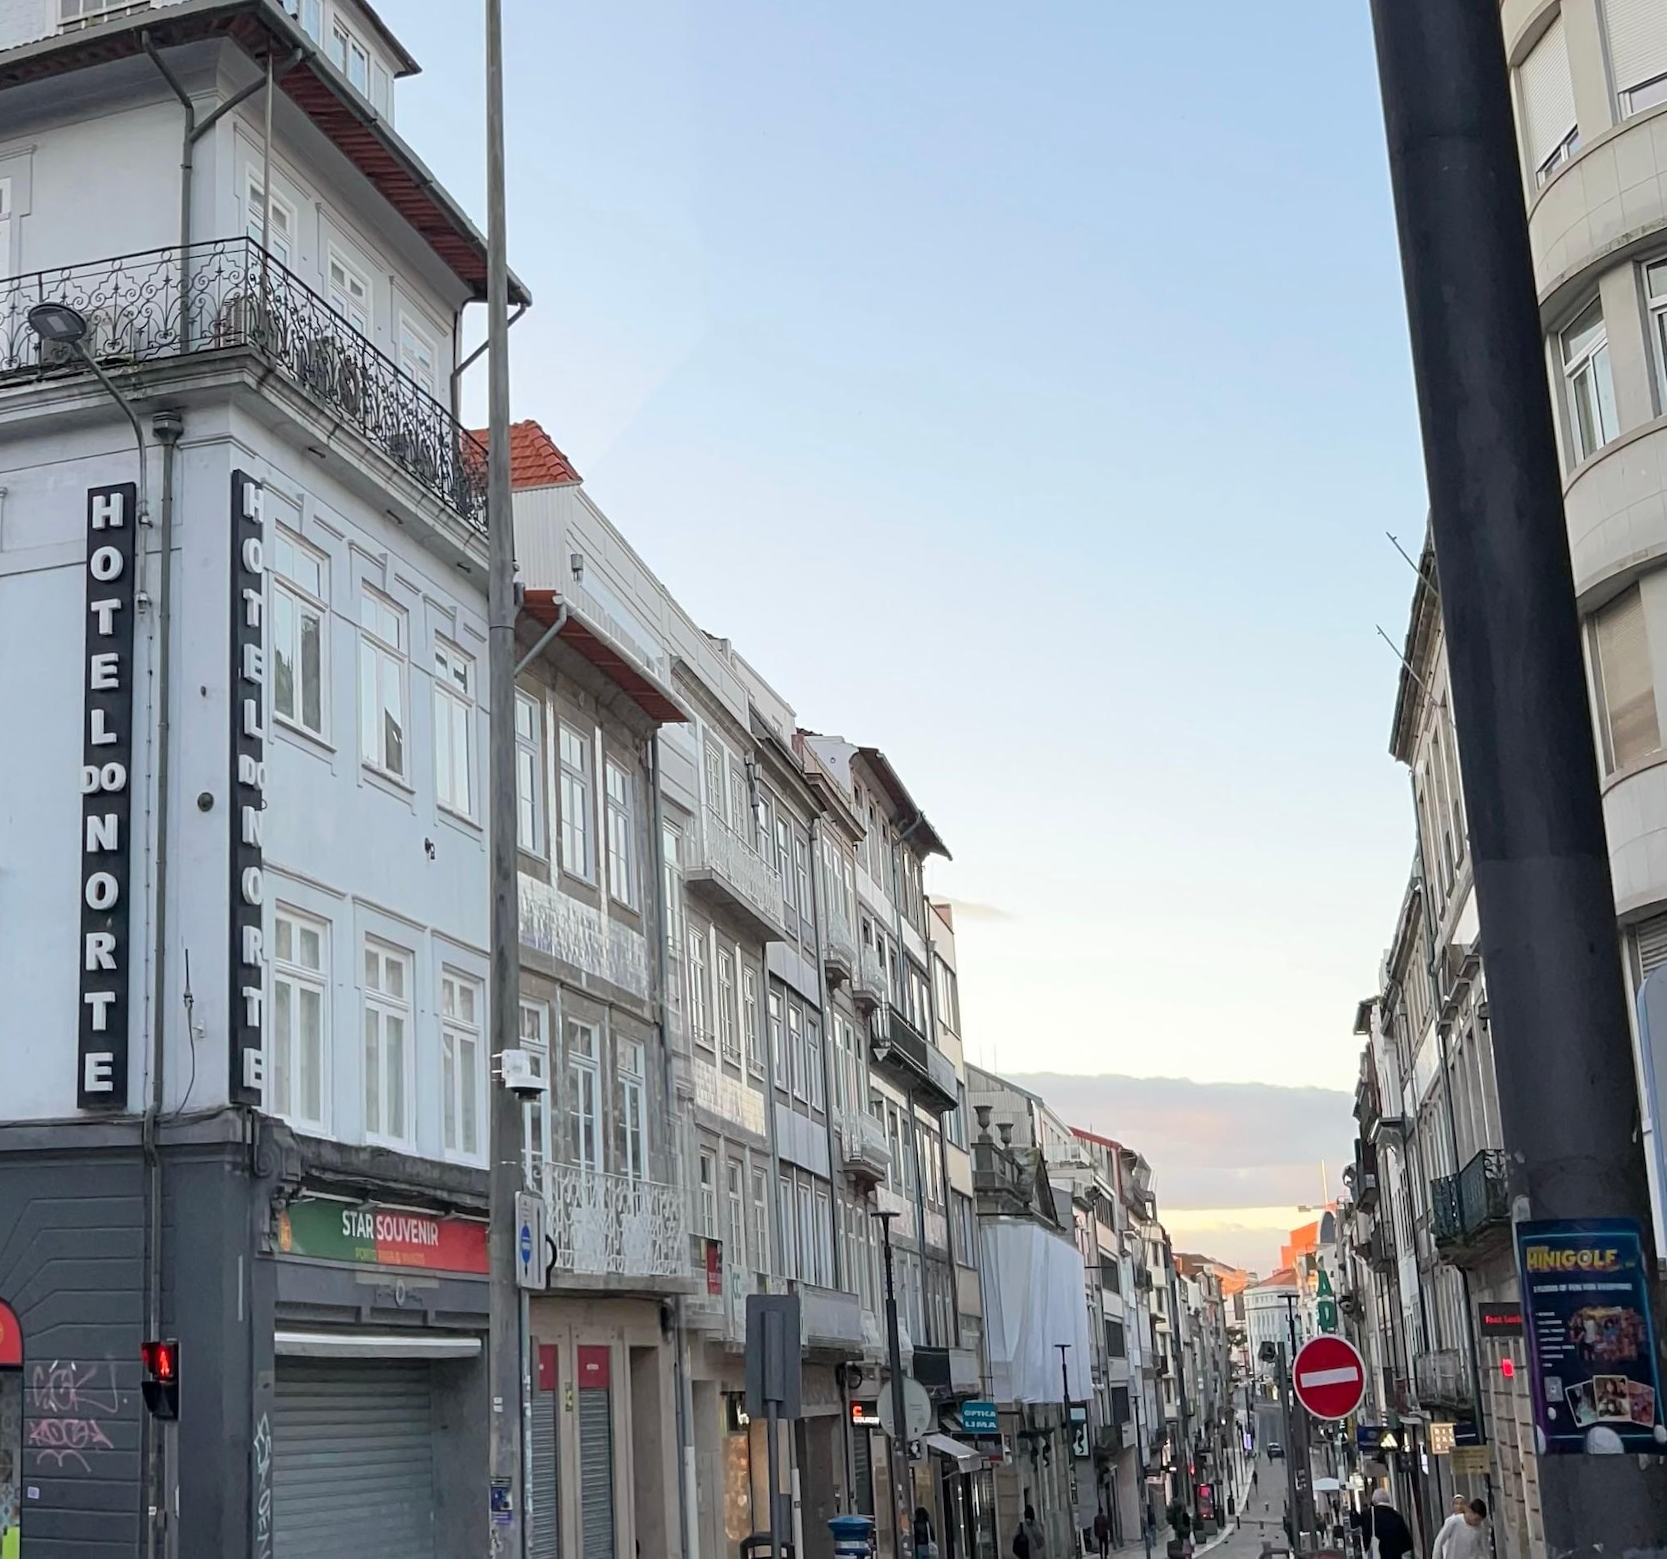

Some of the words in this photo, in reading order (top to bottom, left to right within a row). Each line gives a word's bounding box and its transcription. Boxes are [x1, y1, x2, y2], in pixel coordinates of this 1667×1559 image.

[88, 492, 126, 746] HOTEL
[241, 482, 264, 739] HOTEL
[80, 760, 127, 795] DO
[83, 813, 120, 1093] NORTE
[241, 805, 264, 1092] NORTE
[342, 1210, 374, 1239] STAR
[376, 1215, 439, 1246] SOUVENIR
[1526, 1247, 1618, 1272] MINIGOLF
[963, 1409, 996, 1418] OPTICA
[965, 1420, 997, 1429] LIMA
